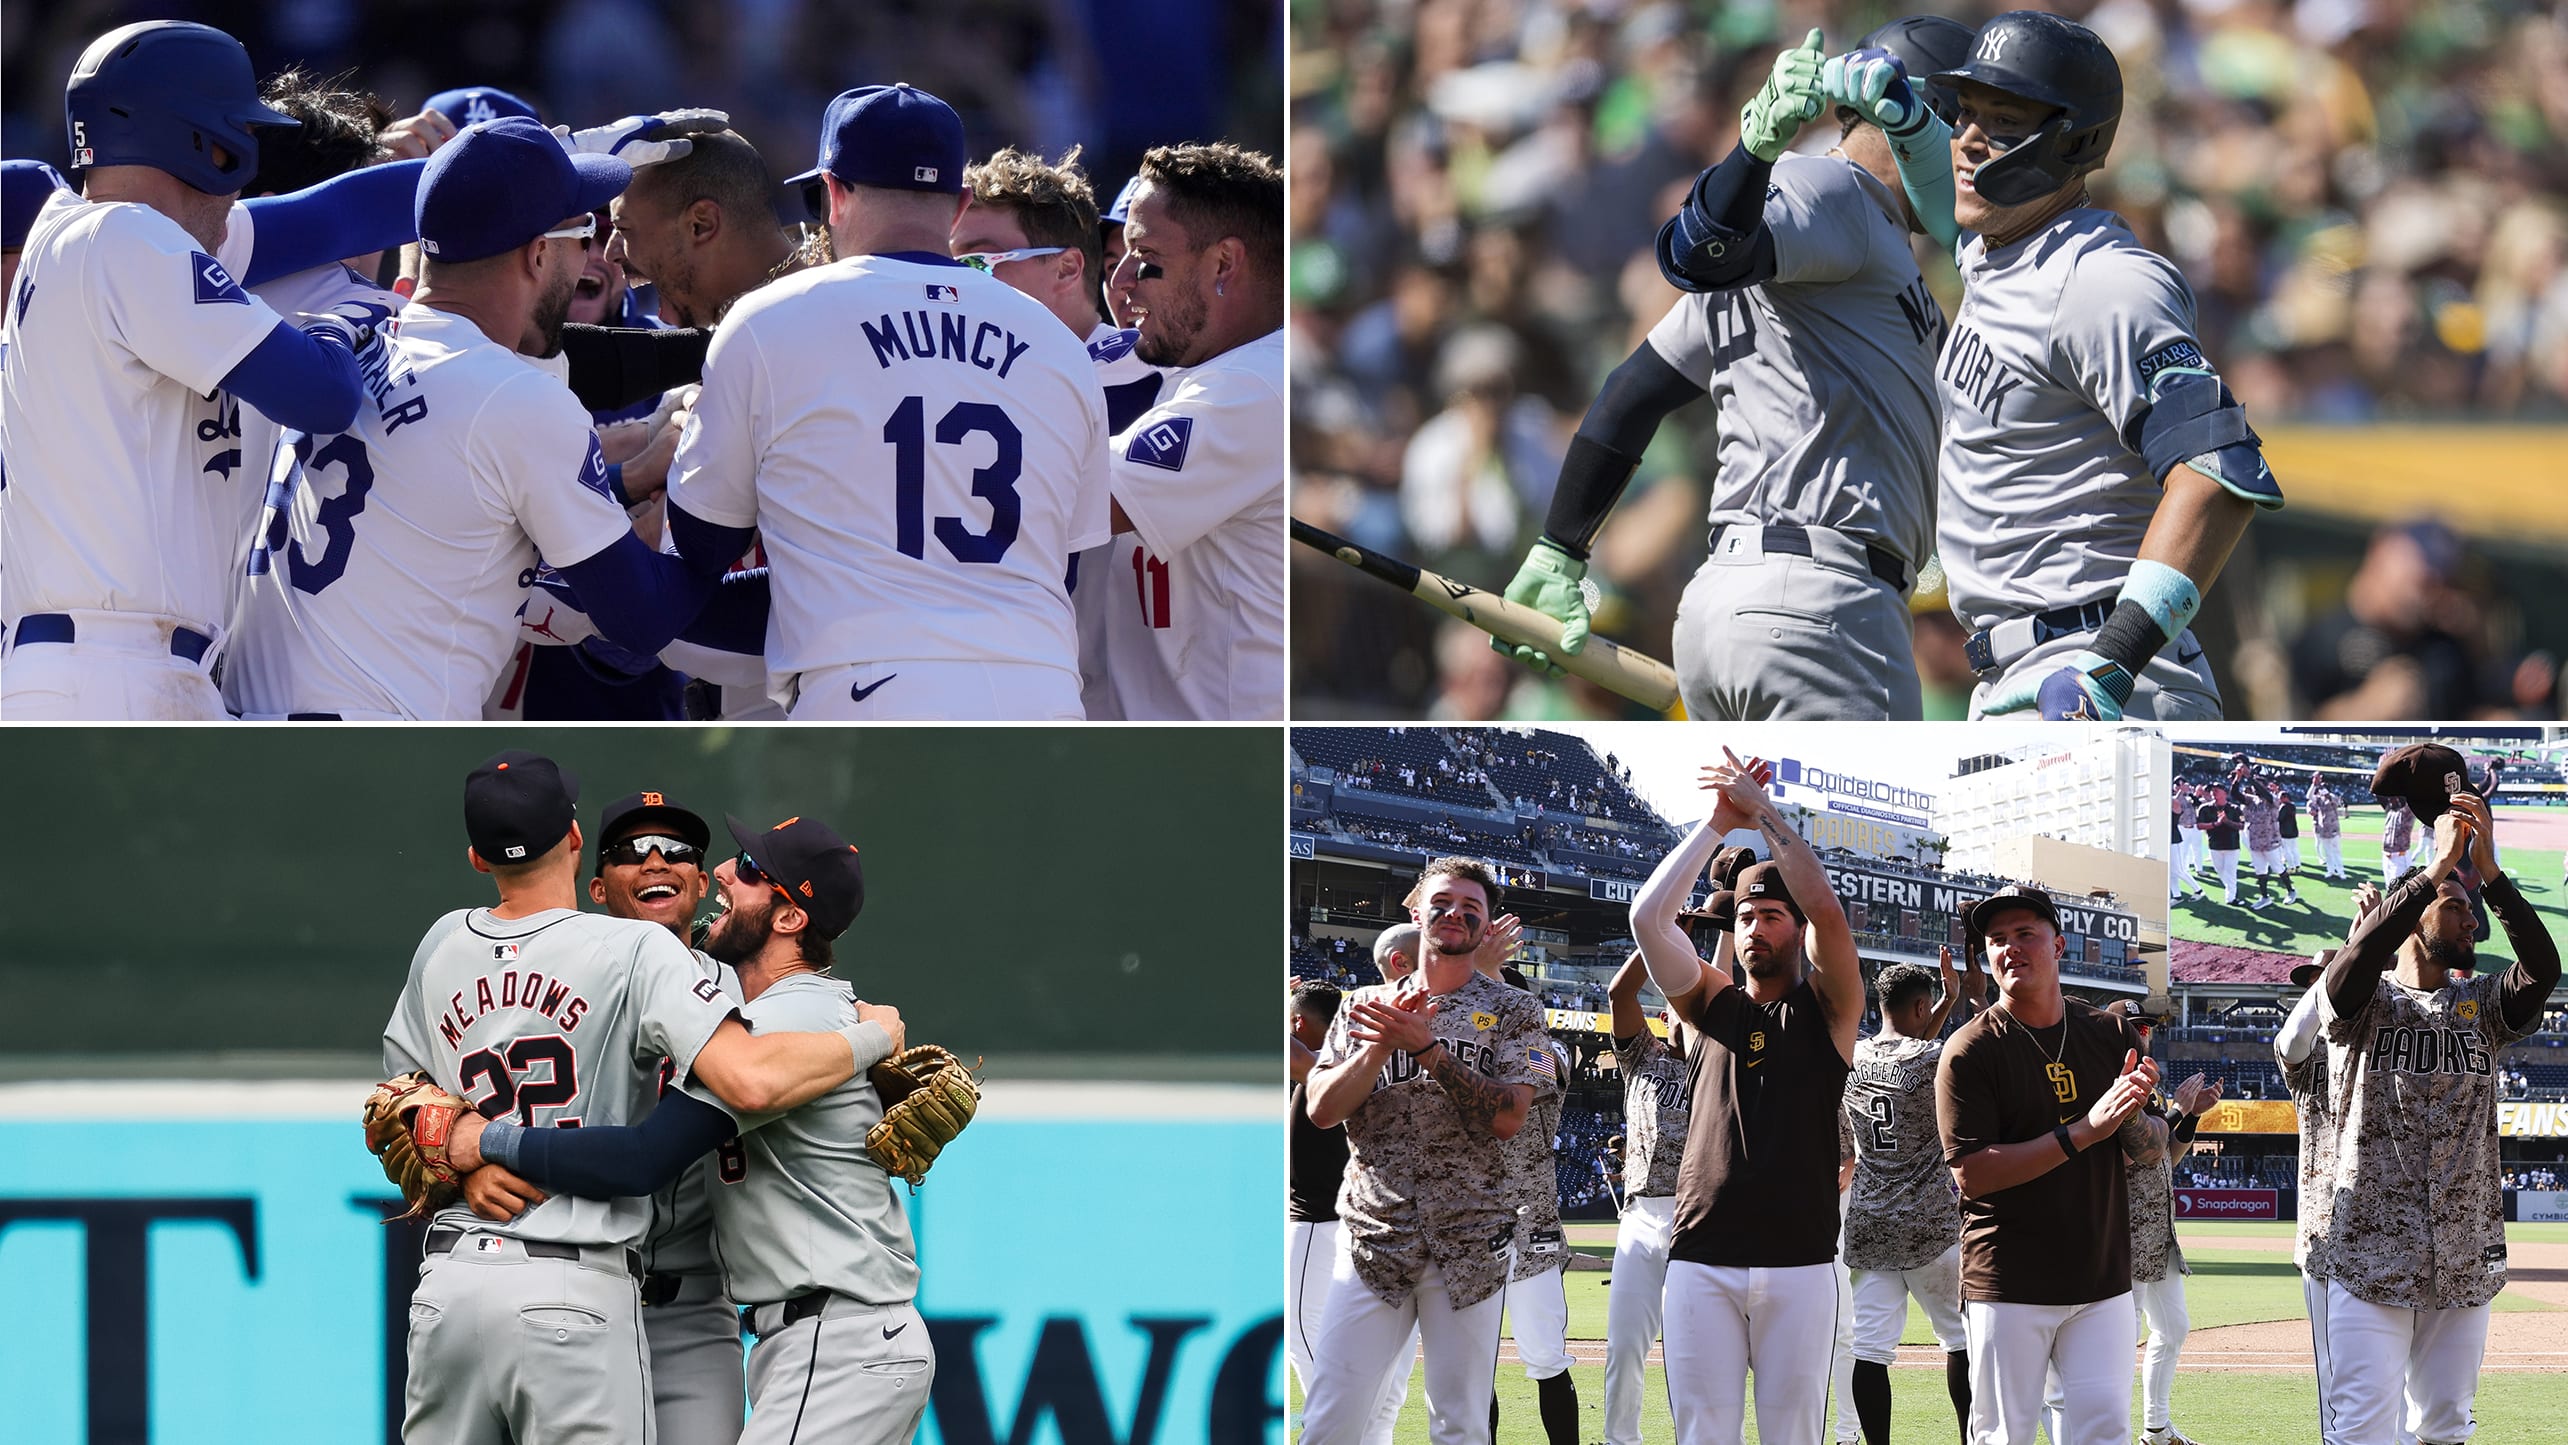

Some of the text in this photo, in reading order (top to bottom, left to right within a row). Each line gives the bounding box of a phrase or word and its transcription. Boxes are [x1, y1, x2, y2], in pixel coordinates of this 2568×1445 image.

[1976, 26, 2009, 63] NY
[74, 121, 86, 147] 5
[1895, 273, 1938, 346] NE
[860, 310, 1030, 379] MUNCY
[2140, 340, 2194, 376] STARR
[1942, 324, 2024, 429] YORK
[884, 396, 1022, 564] 13
[1132, 545, 1171, 629] 11
[641, 791, 665, 806] D
[1807, 767, 1930, 811] QuidelOrtho
[1832, 802, 1927, 827] OFFICIAL DIAGNOSTICS PARTNER
[1290, 842, 1311, 855] AS
[1812, 817, 1896, 856] PADRES
[1605, 882, 1639, 902] CUT
[1826, 869, 1921, 908] ESTERN
[2057, 907, 2096, 935] PLY
[2104, 915, 2137, 943] CO.
[438, 970, 590, 1053] MEADOWS
[1476, 1015, 1491, 1027] PS
[1552, 1011, 1598, 1032] FANS
[2460, 1003, 2474, 1015] PS
[2368, 1026, 2493, 1078] PADRES
[457, 1034, 584, 1128] 22
[1869, 1093, 1898, 1152] 2
[2197, 1197, 2270, 1213] Snapdragon
